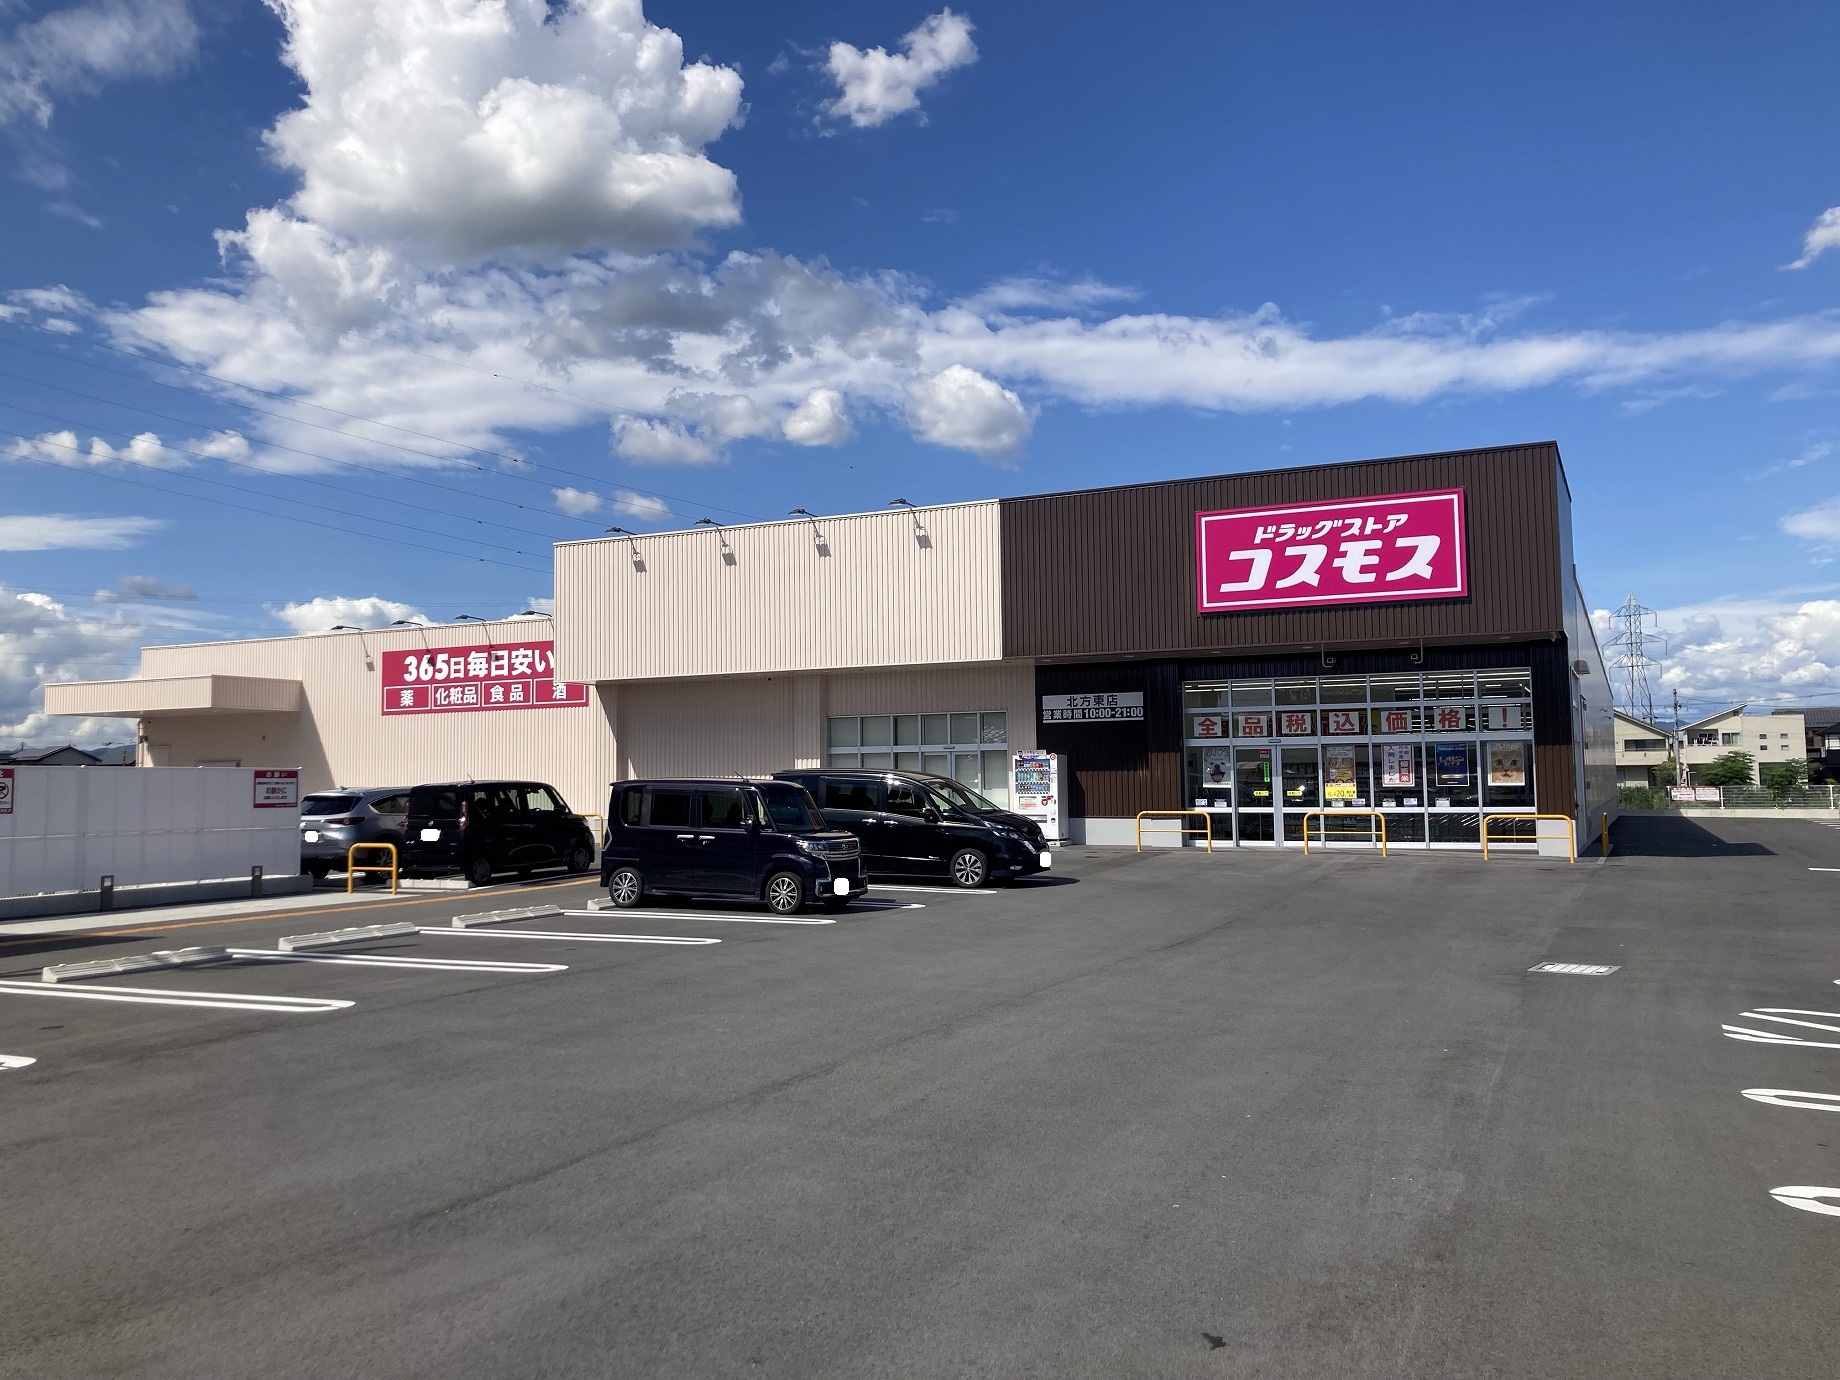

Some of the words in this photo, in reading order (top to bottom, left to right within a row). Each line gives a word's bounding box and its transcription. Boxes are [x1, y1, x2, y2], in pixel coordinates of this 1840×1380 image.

[1254, 513, 1409, 544] ドラッグストア
[1219, 534, 1441, 593] コスモス
[403, 648, 554, 682] 365日毎日安い
[400, 690, 414, 707] 薬
[435, 686, 477, 705] 化粧品
[490, 683, 524, 703] 食品
[552, 682, 567, 700] 酒
[1066, 694, 1118, 707] 北方東店
